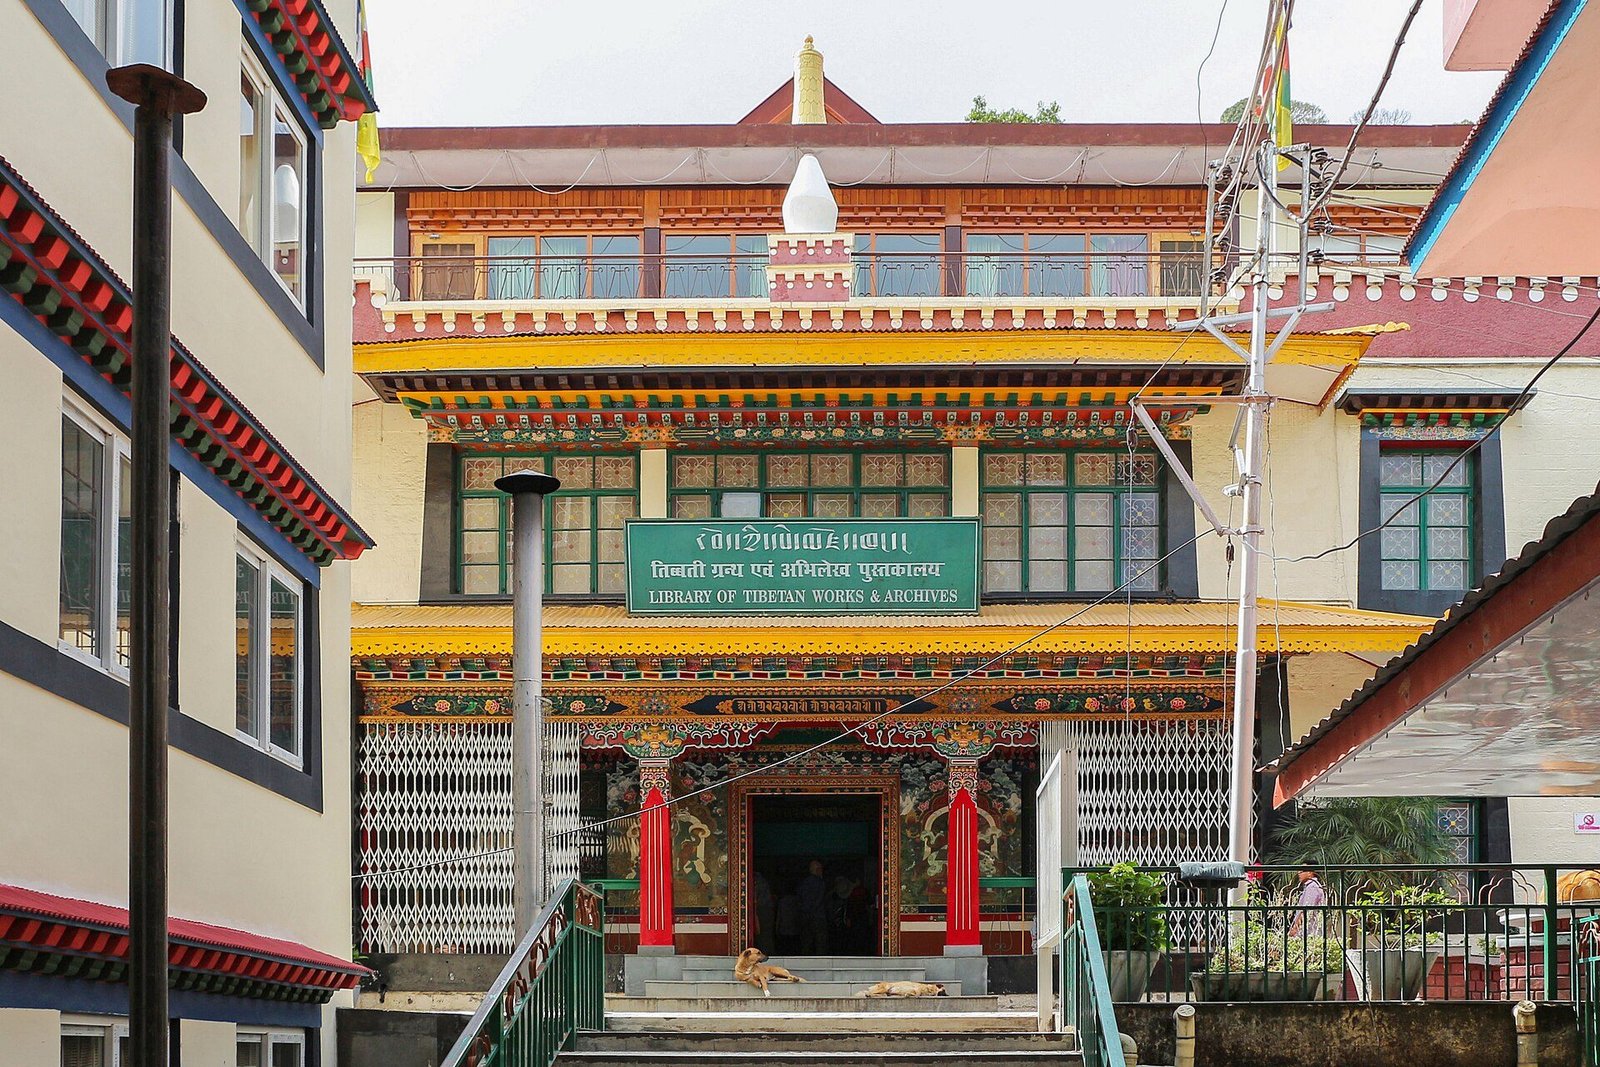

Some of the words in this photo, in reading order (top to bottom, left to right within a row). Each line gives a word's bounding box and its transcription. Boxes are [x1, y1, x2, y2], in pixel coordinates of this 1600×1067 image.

[650, 560, 707, 579] तिब्बती
[750, 560, 774, 578] एवं
[781, 560, 851, 578] अभिलेख
[857, 562, 945, 583] पुस्तकालय
[649, 589, 713, 604] LIBRARY
[717, 589, 737, 604] OF
[743, 589, 806, 604] TIBETAN
[812, 589, 864, 604] WORKS
[870, 589, 881, 603] &
[884, 588, 958, 603] ARCHIVES
